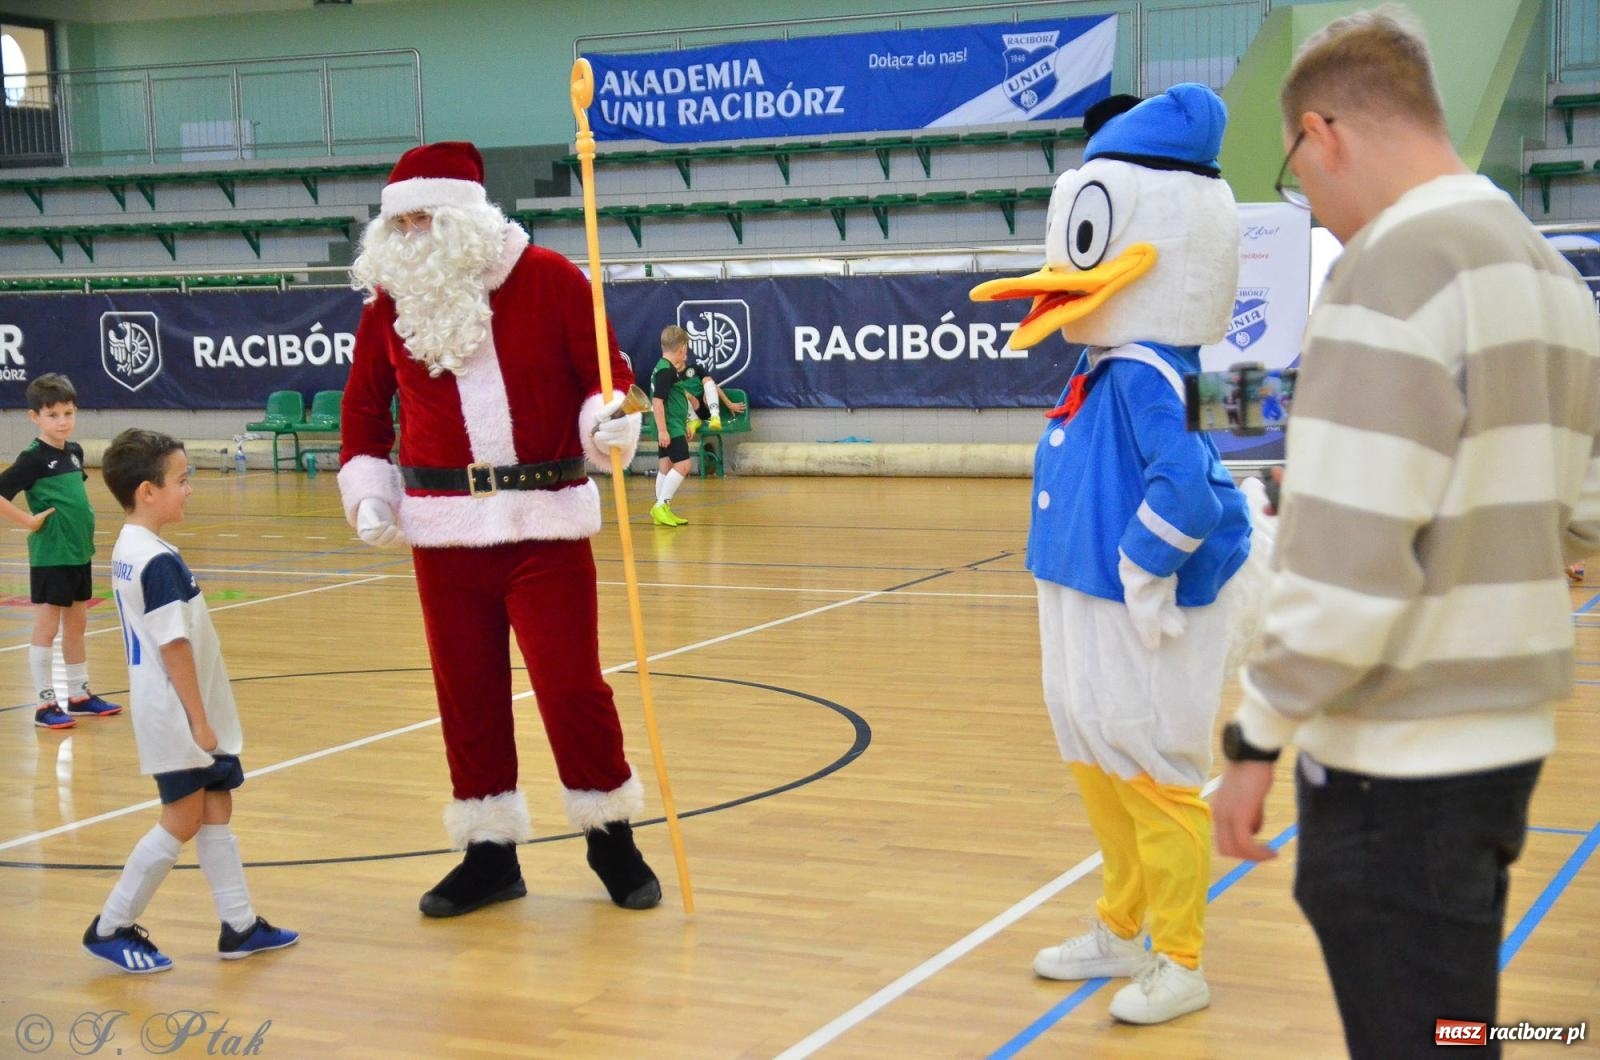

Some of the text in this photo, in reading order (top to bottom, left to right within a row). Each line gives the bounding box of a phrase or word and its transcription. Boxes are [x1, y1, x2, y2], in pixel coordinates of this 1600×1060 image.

[600, 58, 764, 96] AKADEMIA
[869, 47, 968, 70] Dołącz do nas!
[1008, 61, 1051, 92] UNIA
[601, 81, 845, 127] UNII RACIBÓRZ
[193, 321, 356, 367] RACIBÓR
[794, 310, 1029, 360] RACIBÓRZ
